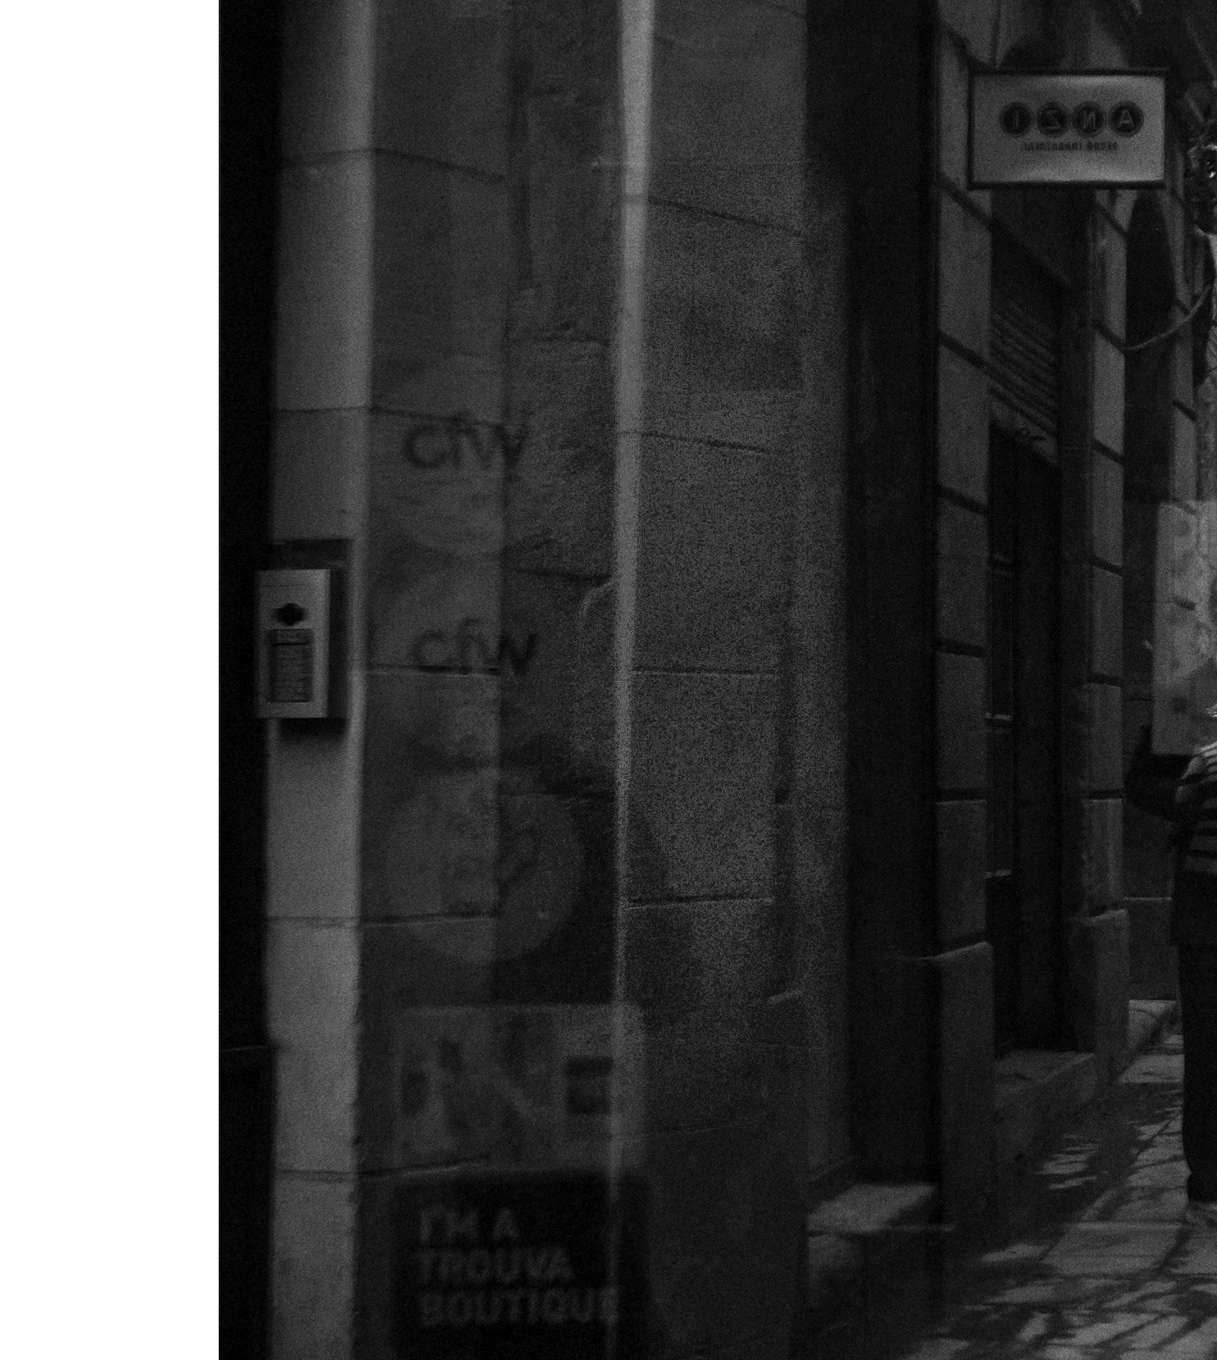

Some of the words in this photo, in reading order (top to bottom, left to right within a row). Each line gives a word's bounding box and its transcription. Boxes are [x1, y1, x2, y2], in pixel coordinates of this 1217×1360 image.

[420, 1206, 479, 1242] I'M
[492, 1206, 520, 1241] A
[417, 1247, 573, 1283] TROUVA
